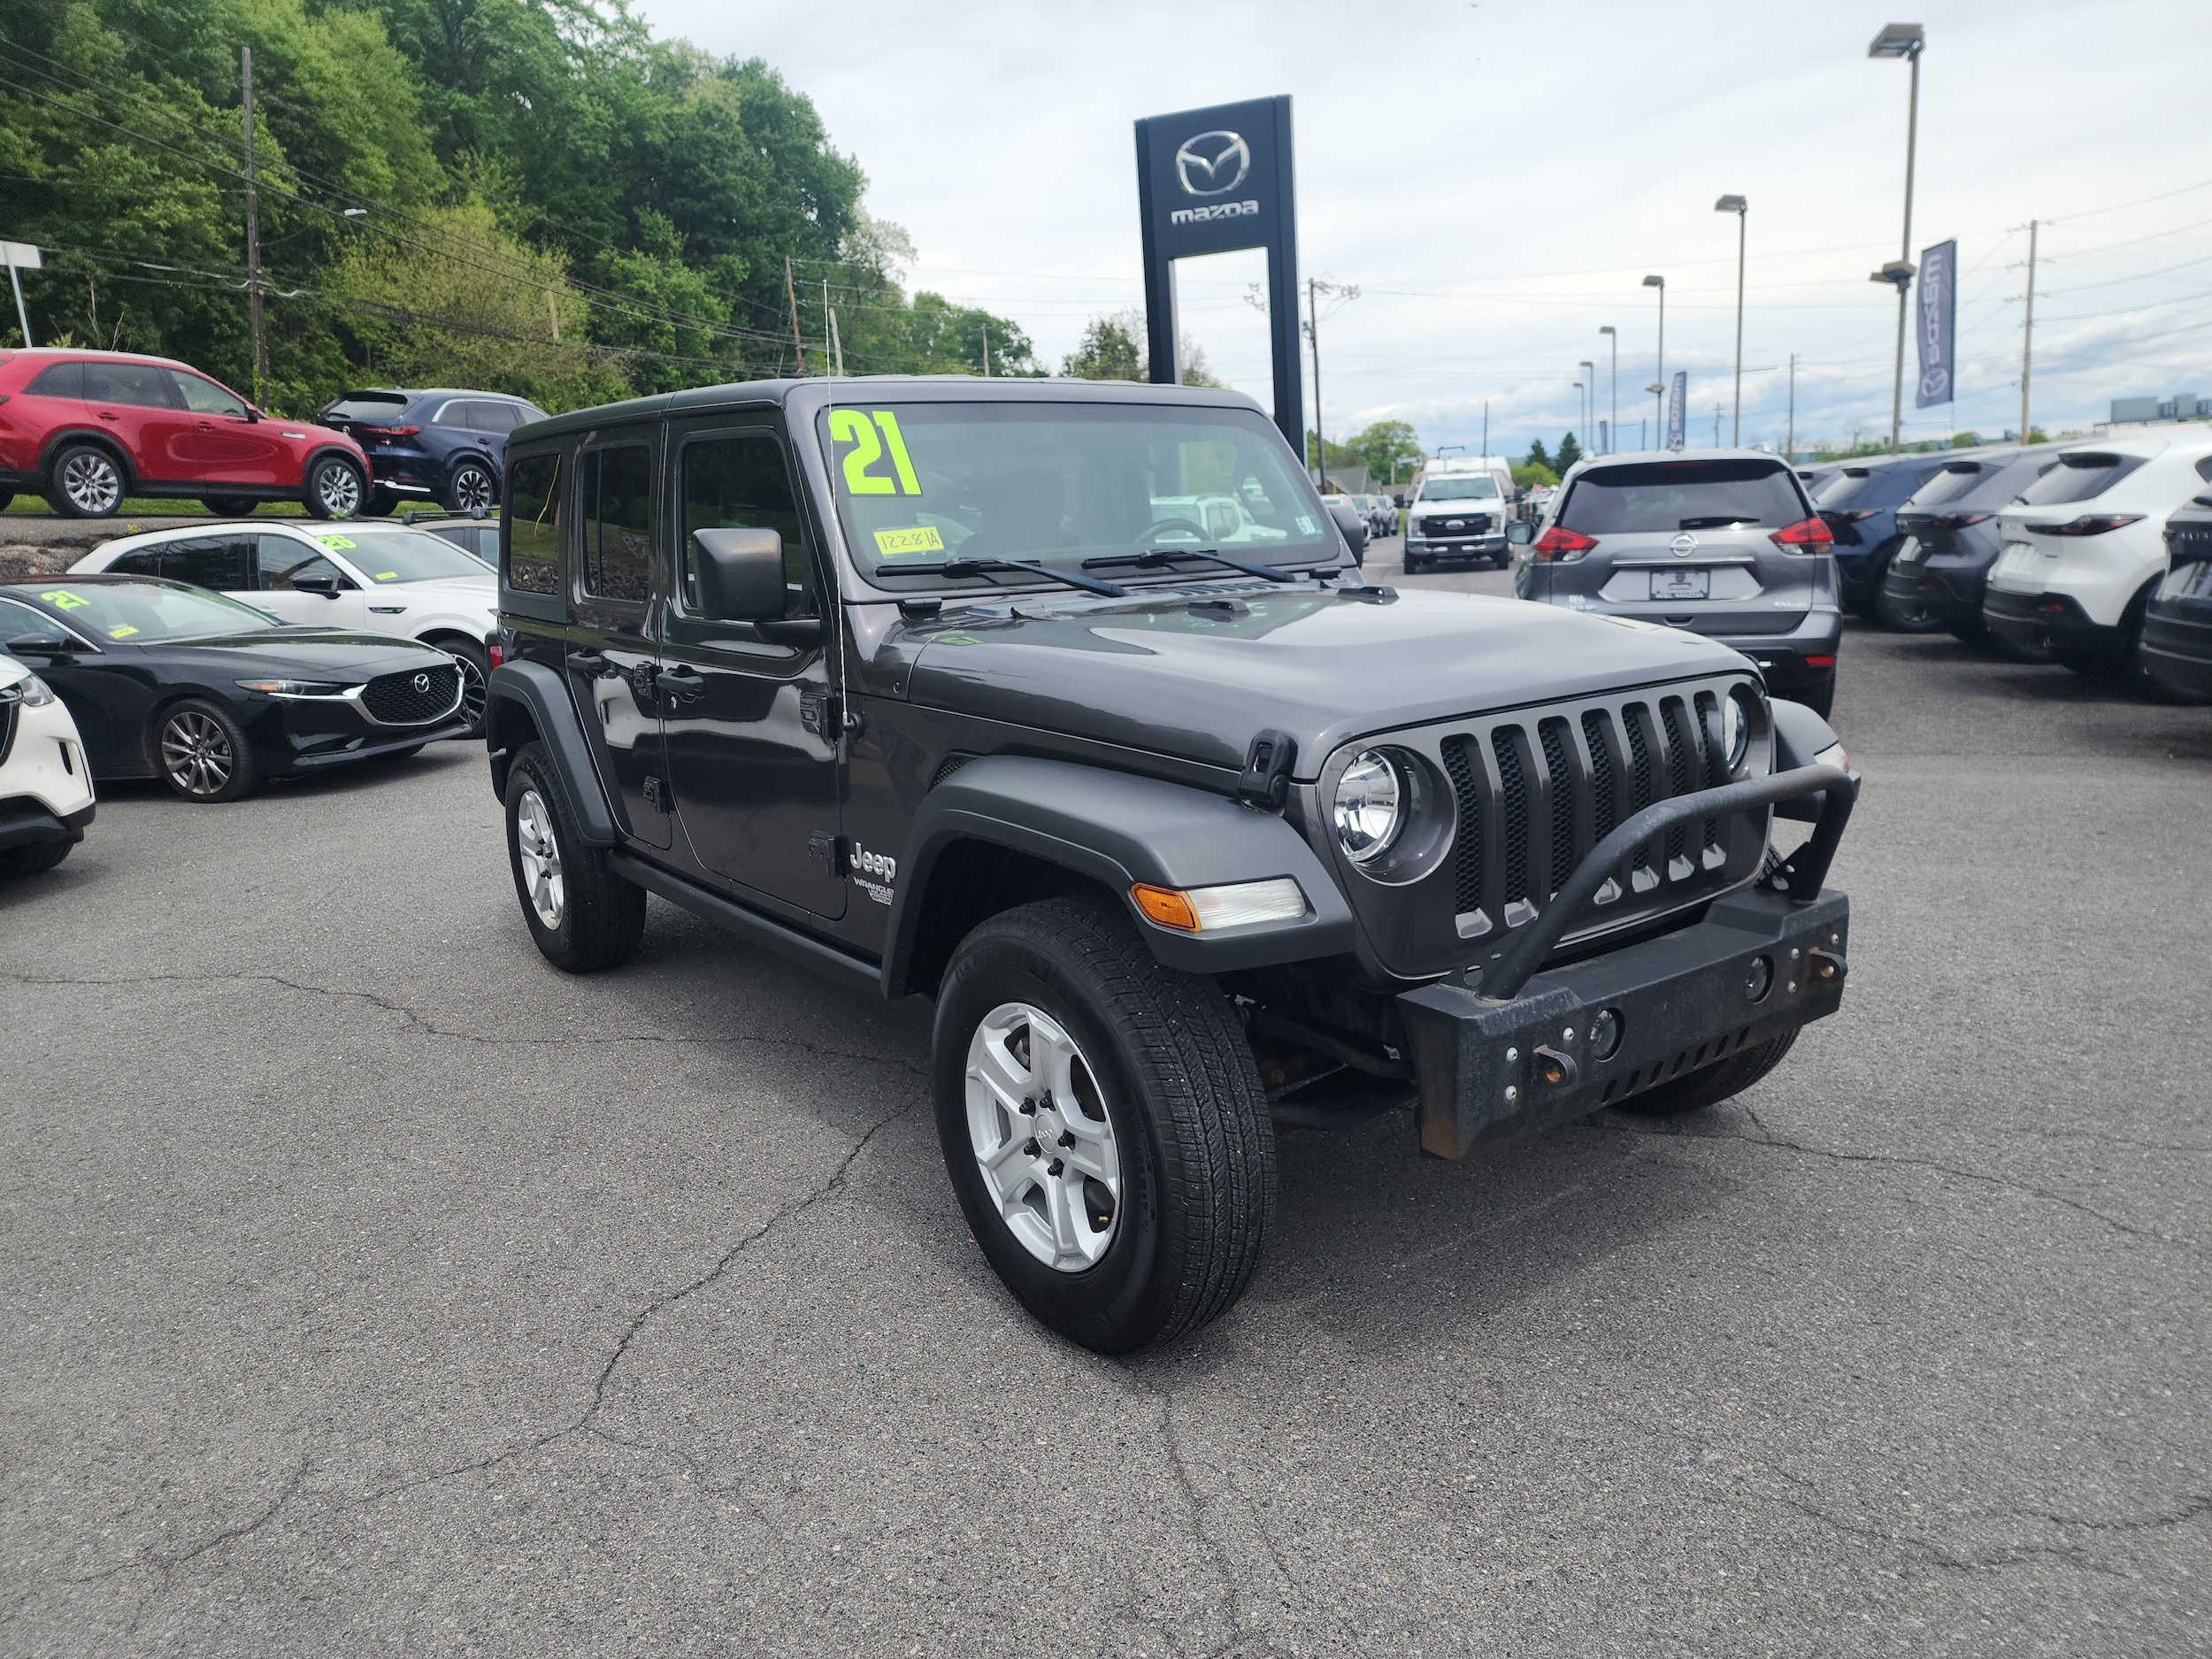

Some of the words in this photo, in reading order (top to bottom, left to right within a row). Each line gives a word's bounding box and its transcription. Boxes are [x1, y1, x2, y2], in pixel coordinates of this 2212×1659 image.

[1171, 199, 1259, 226] mazda
[827, 409, 922, 495] 21
[316, 534, 357, 551] 26
[40, 589, 90, 610] 21
[849, 841, 897, 883] Jeep
